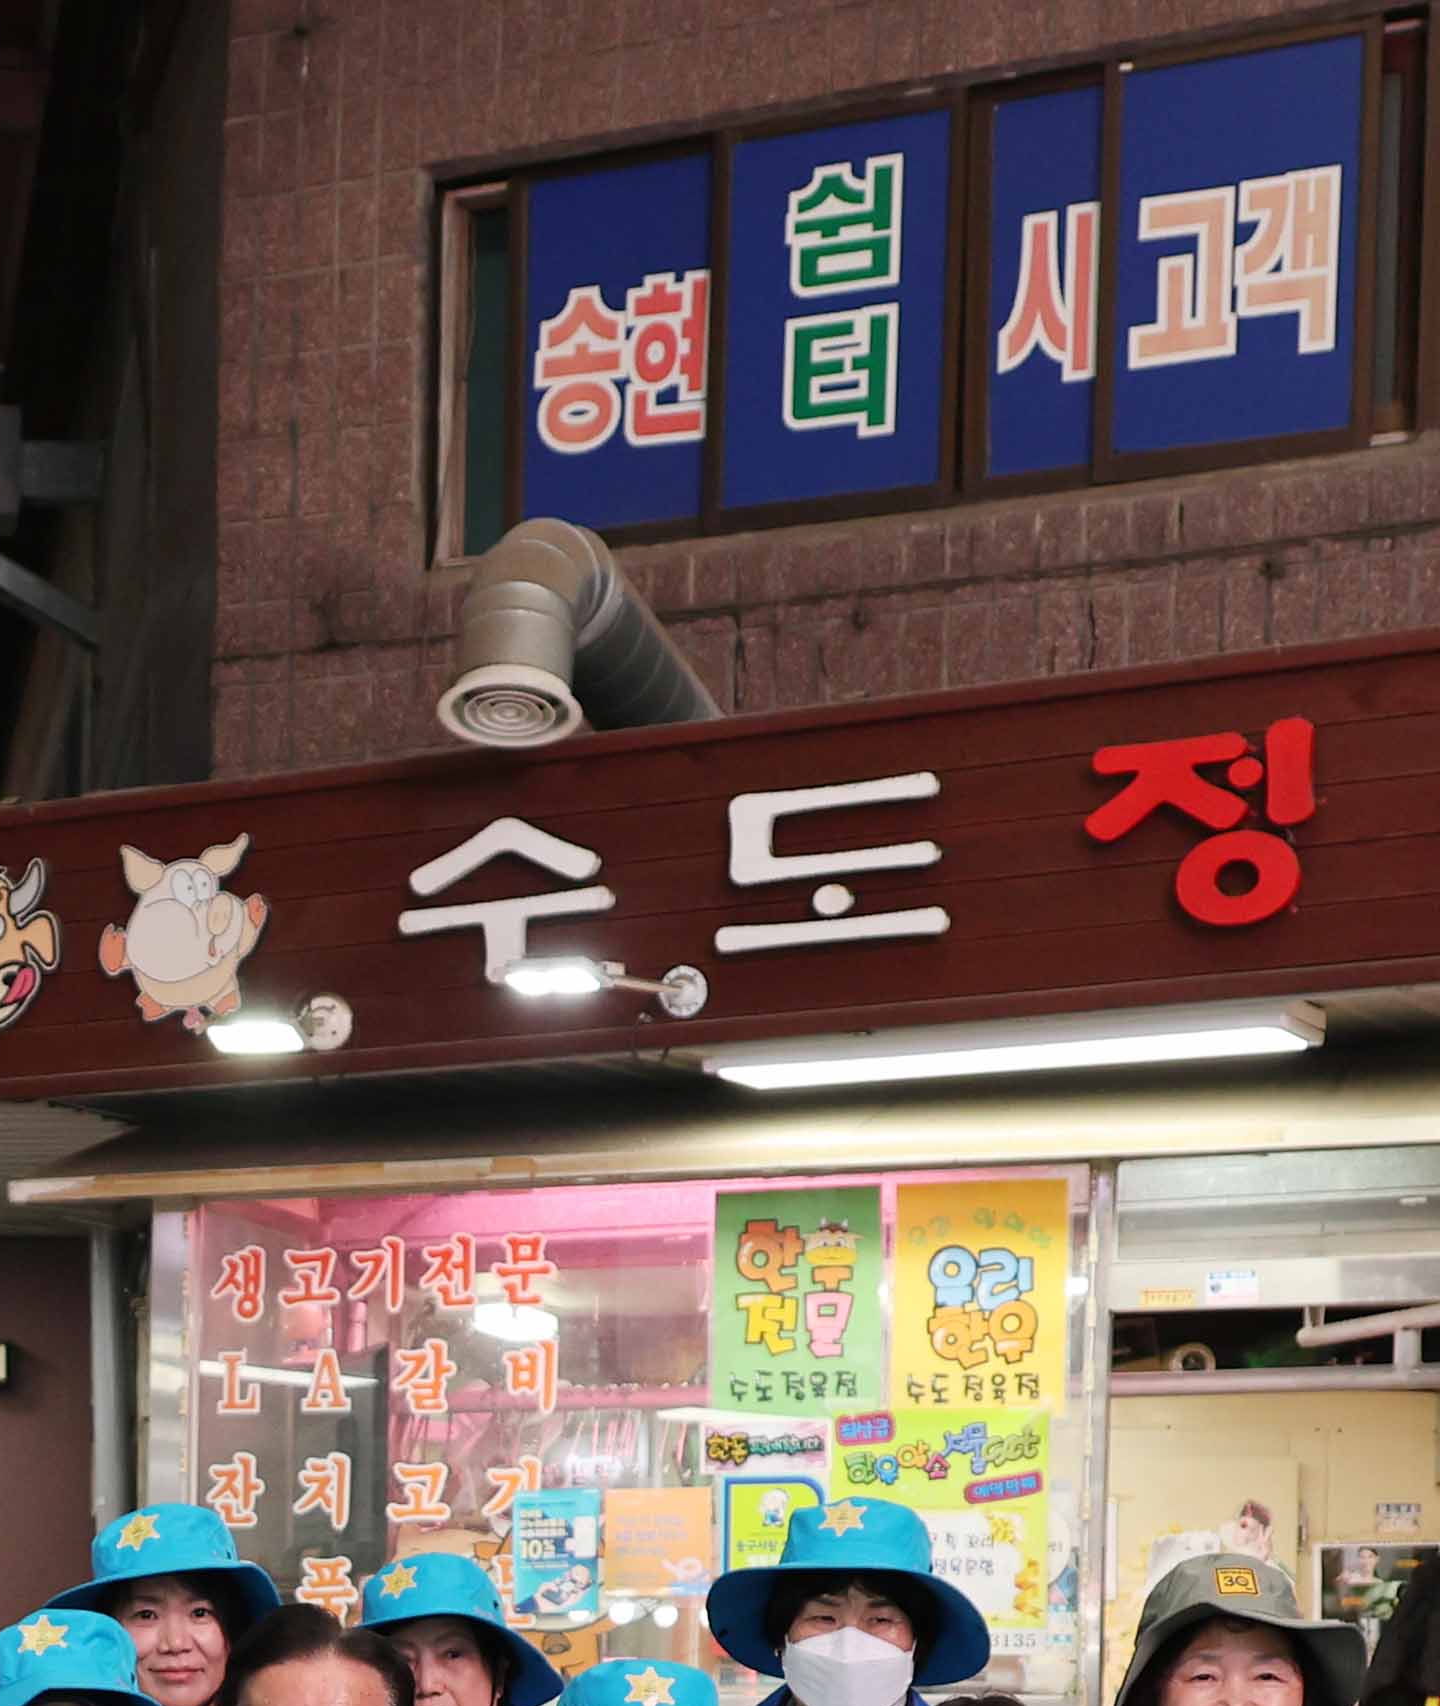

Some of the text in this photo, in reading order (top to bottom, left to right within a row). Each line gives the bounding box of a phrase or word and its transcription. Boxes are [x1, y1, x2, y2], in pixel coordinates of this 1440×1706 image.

[536, 268, 710, 455] 송현
[1126, 163, 1342, 371] 고객
[398, 769, 950, 984] 수도
[210, 1233, 556, 1320] 생고기전문
[730, 1370, 858, 1401] 수도 정육점
[907, 1373, 1040, 1403] 수도 정육점
[206, 1453, 542, 1531] 잔치고기
